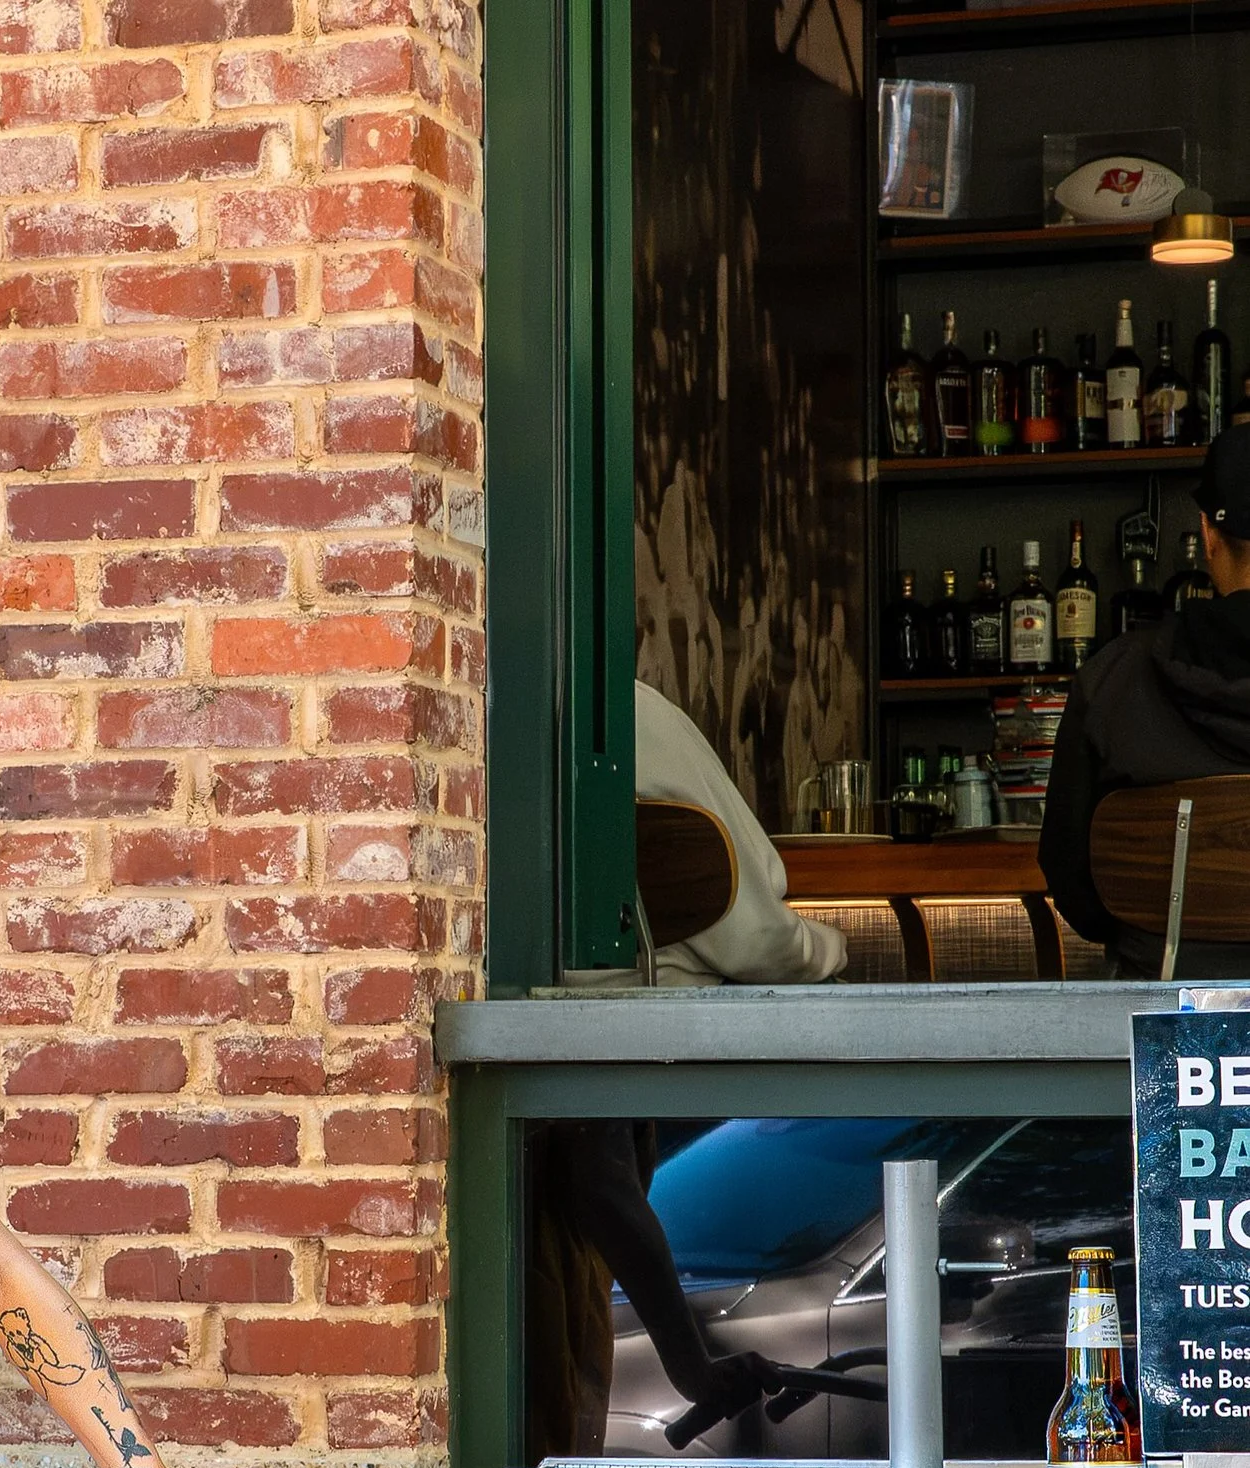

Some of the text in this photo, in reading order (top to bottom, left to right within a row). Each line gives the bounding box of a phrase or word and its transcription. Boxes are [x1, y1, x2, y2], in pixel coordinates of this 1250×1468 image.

[1179, 1340, 1216, 1360] The
[1180, 1368, 1213, 1389] the
[1181, 1397, 1210, 1417] for
